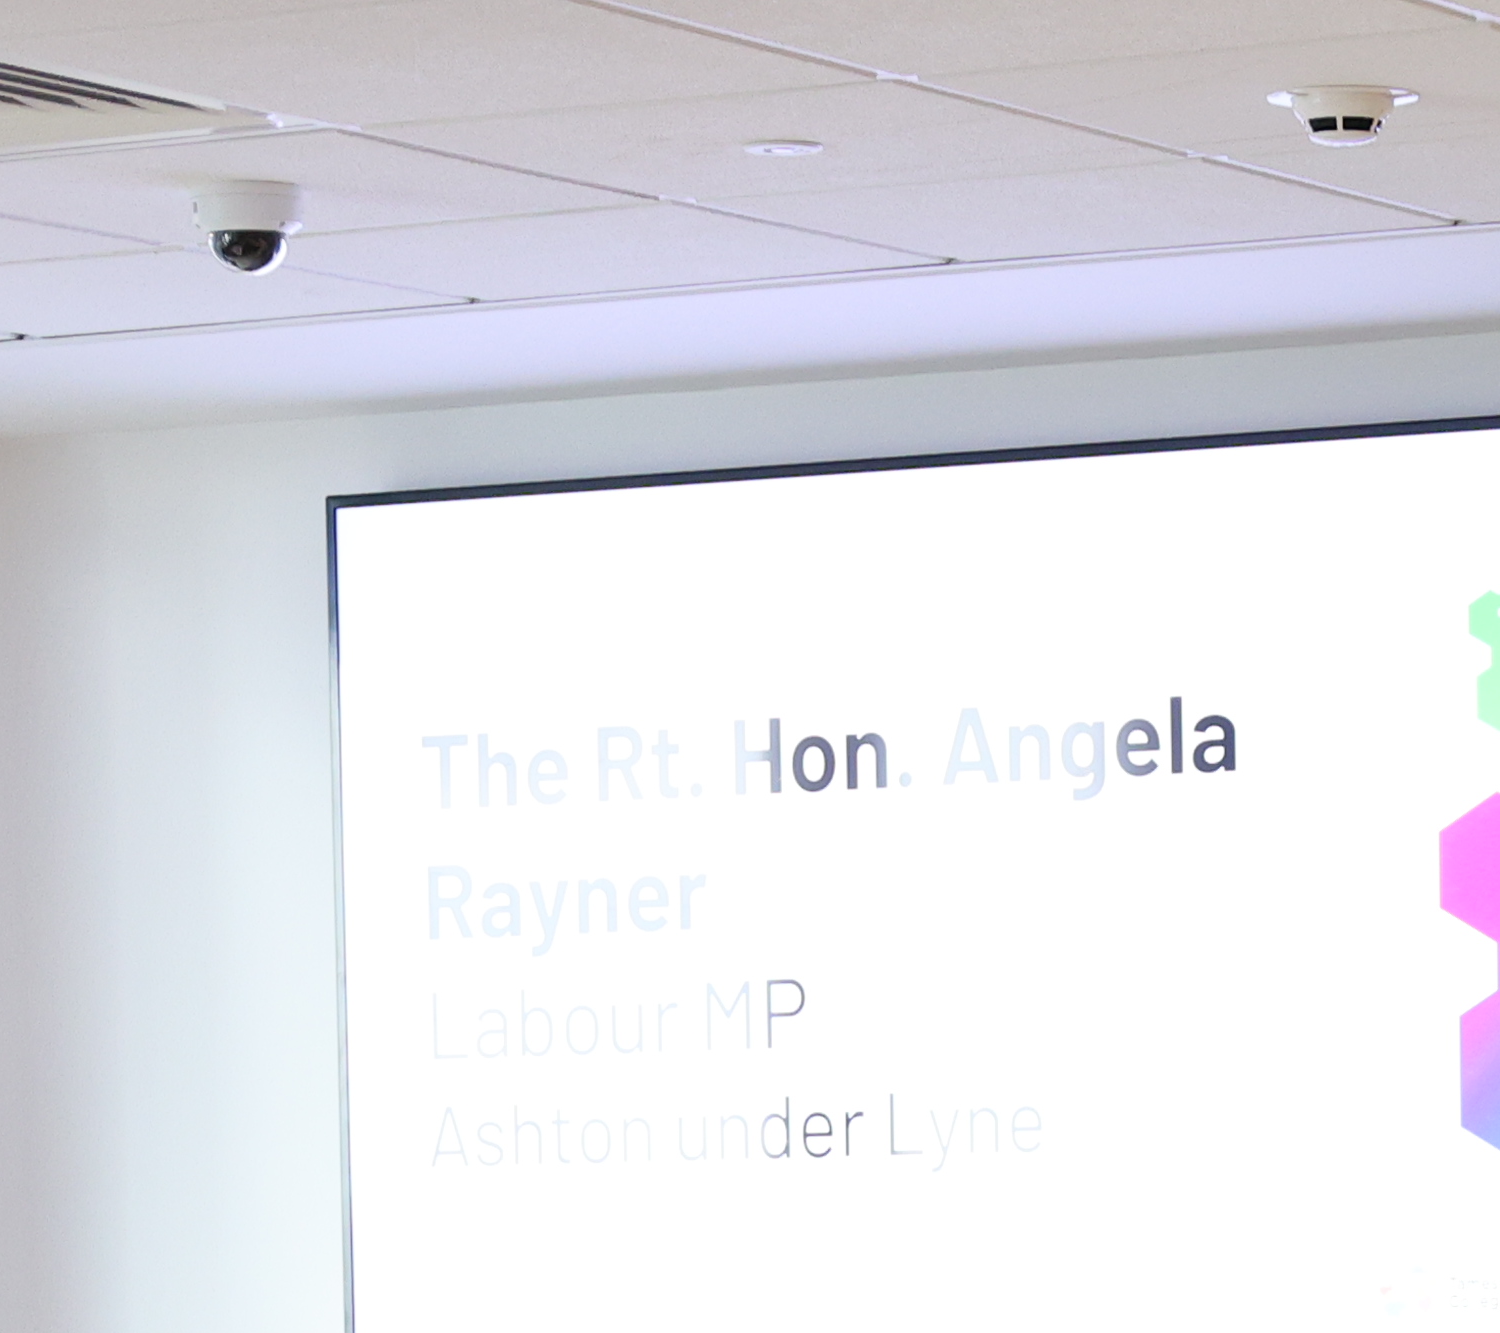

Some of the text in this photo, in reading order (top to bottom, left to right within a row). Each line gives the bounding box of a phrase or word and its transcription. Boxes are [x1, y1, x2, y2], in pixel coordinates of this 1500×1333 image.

[422, 696, 1237, 808] The Rt. Hon. Angela
[428, 866, 706, 956] Rayner
[433, 979, 806, 1059] Labour MP
[432, 1093, 1042, 1172] Ashton under Lyne
